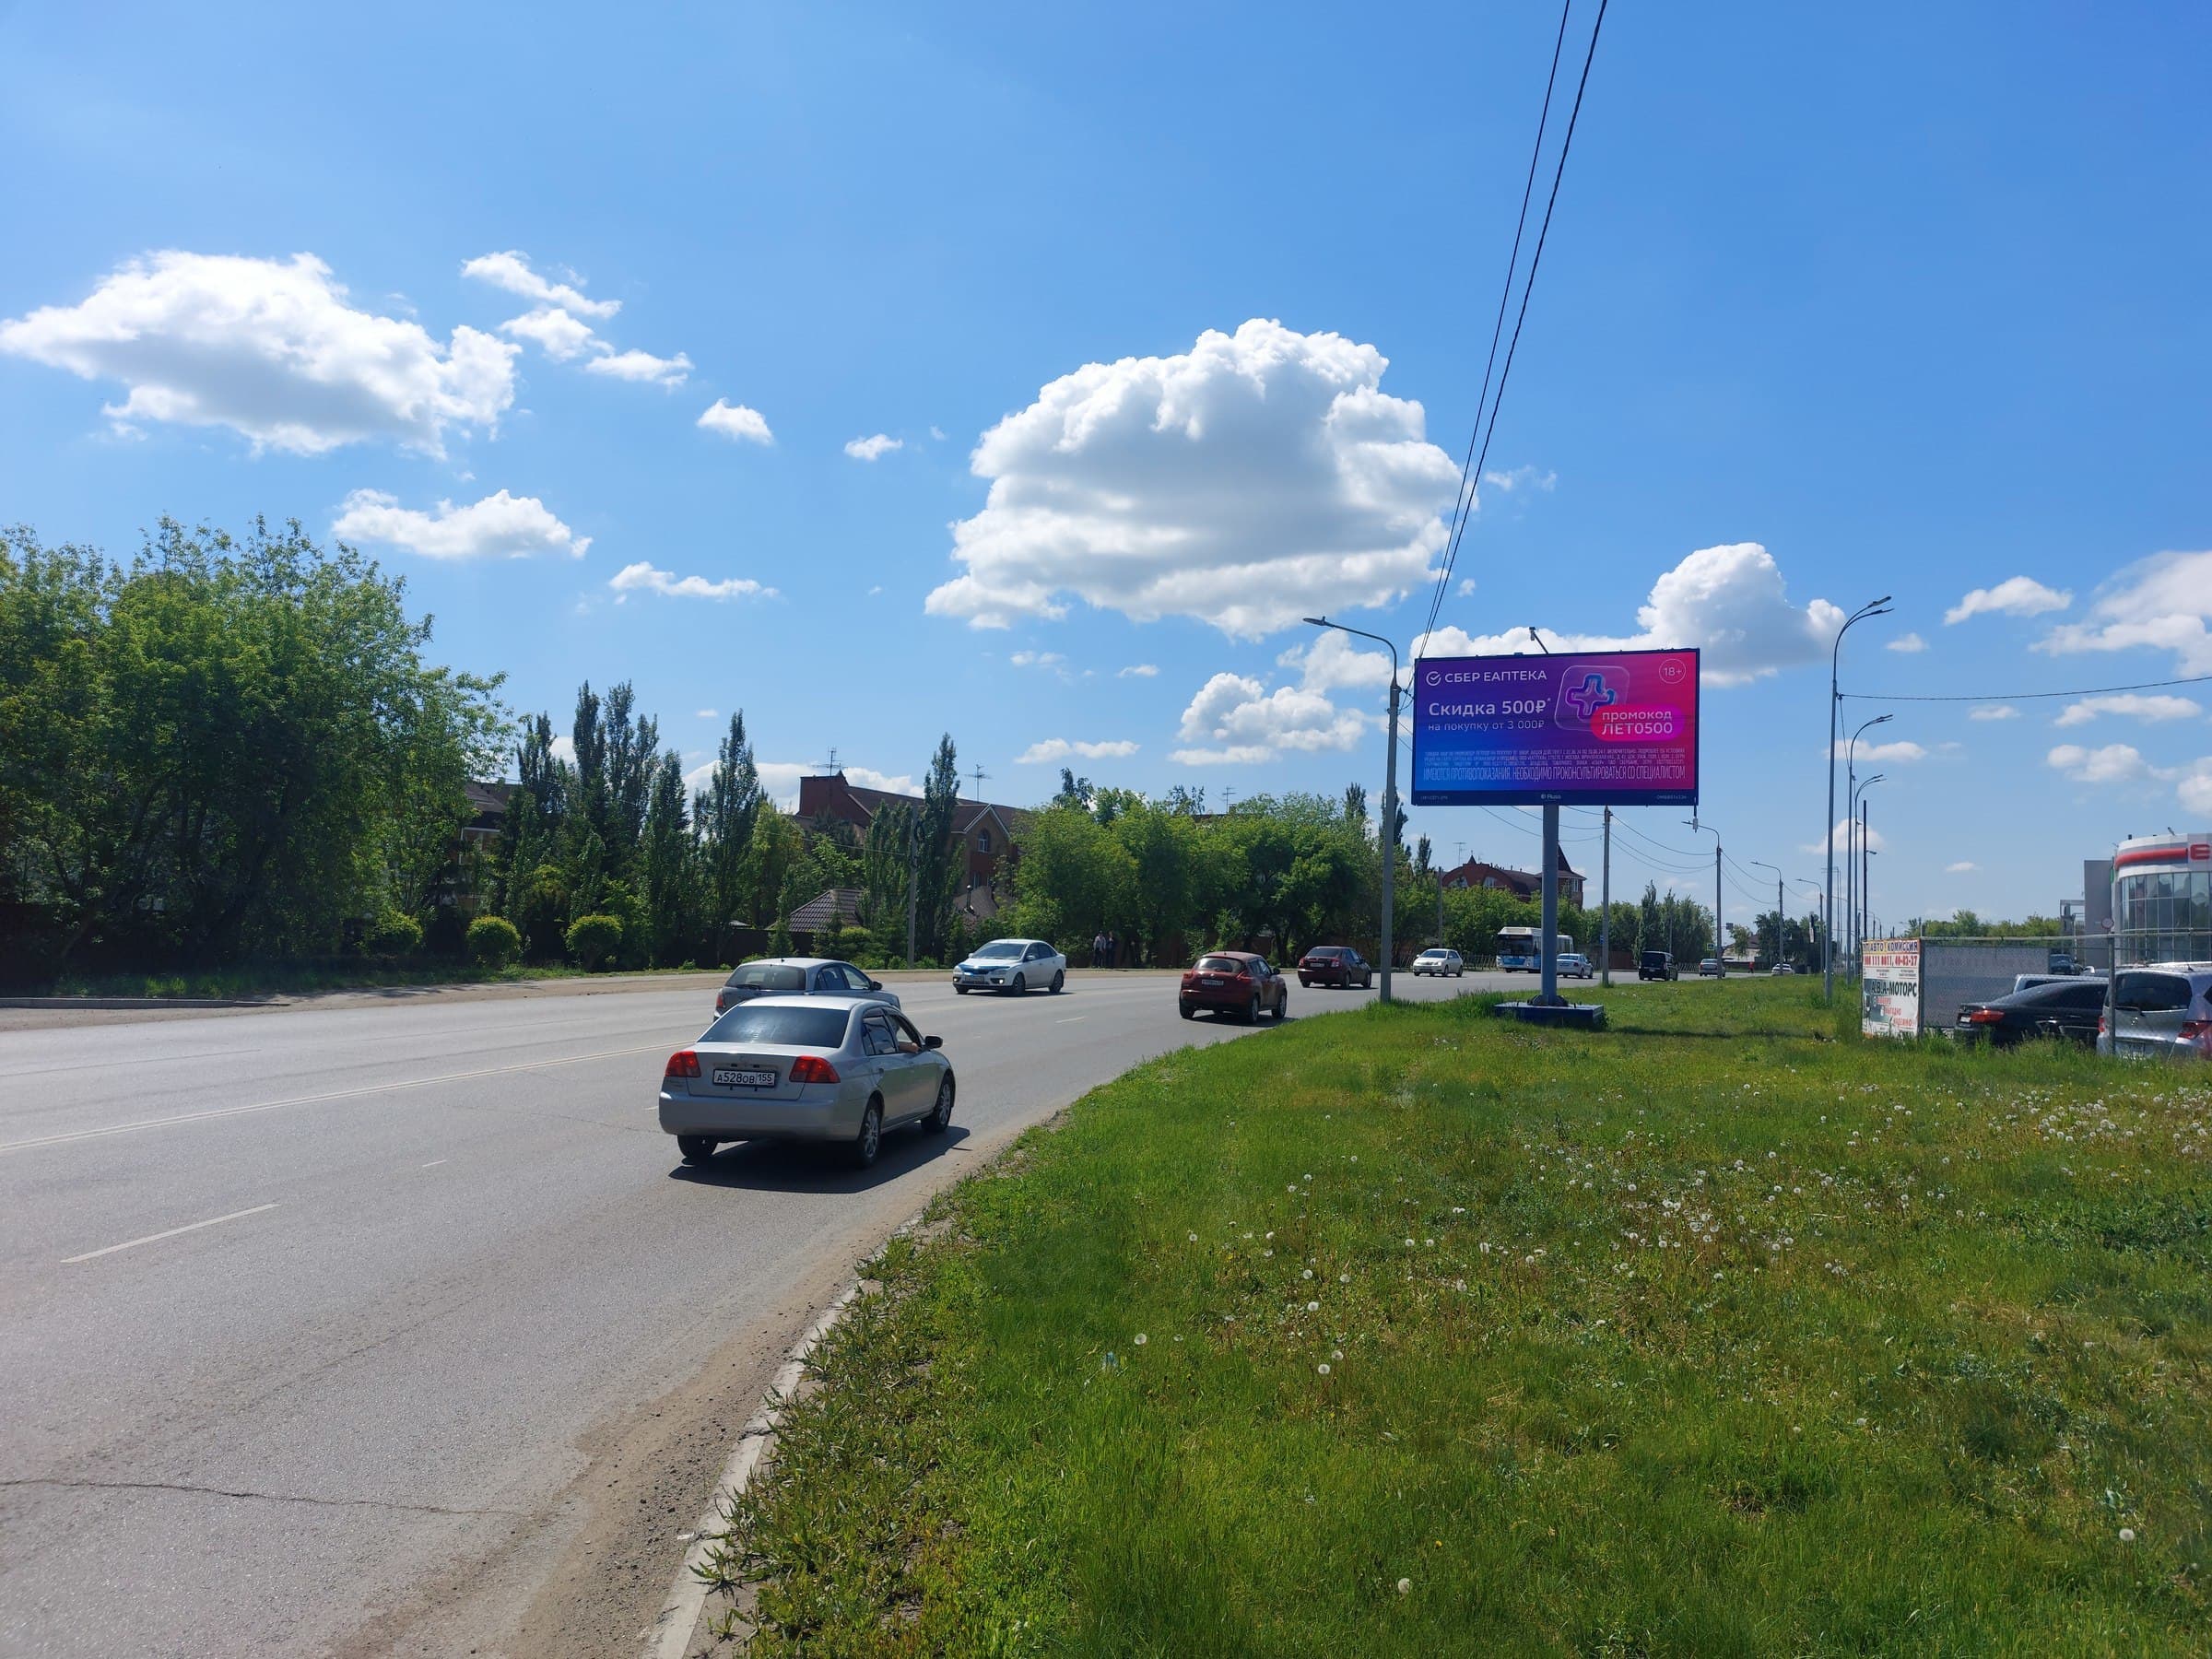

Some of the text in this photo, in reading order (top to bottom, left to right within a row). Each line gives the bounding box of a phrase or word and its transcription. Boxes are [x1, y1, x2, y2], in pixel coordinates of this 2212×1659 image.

[1444, 670, 1547, 683] СБЕР ЕАПТЕКА
[1664, 666, 1682, 677] 18+
[1429, 702, 1496, 717] Скидка
[1602, 711, 1673, 723] промокод
[1444, 722, 1488, 732] покупку
[1492, 722, 1504, 730] от
[1507, 720, 1514, 730] 3
[717, 1072, 772, 1084] А528ОВ 155
